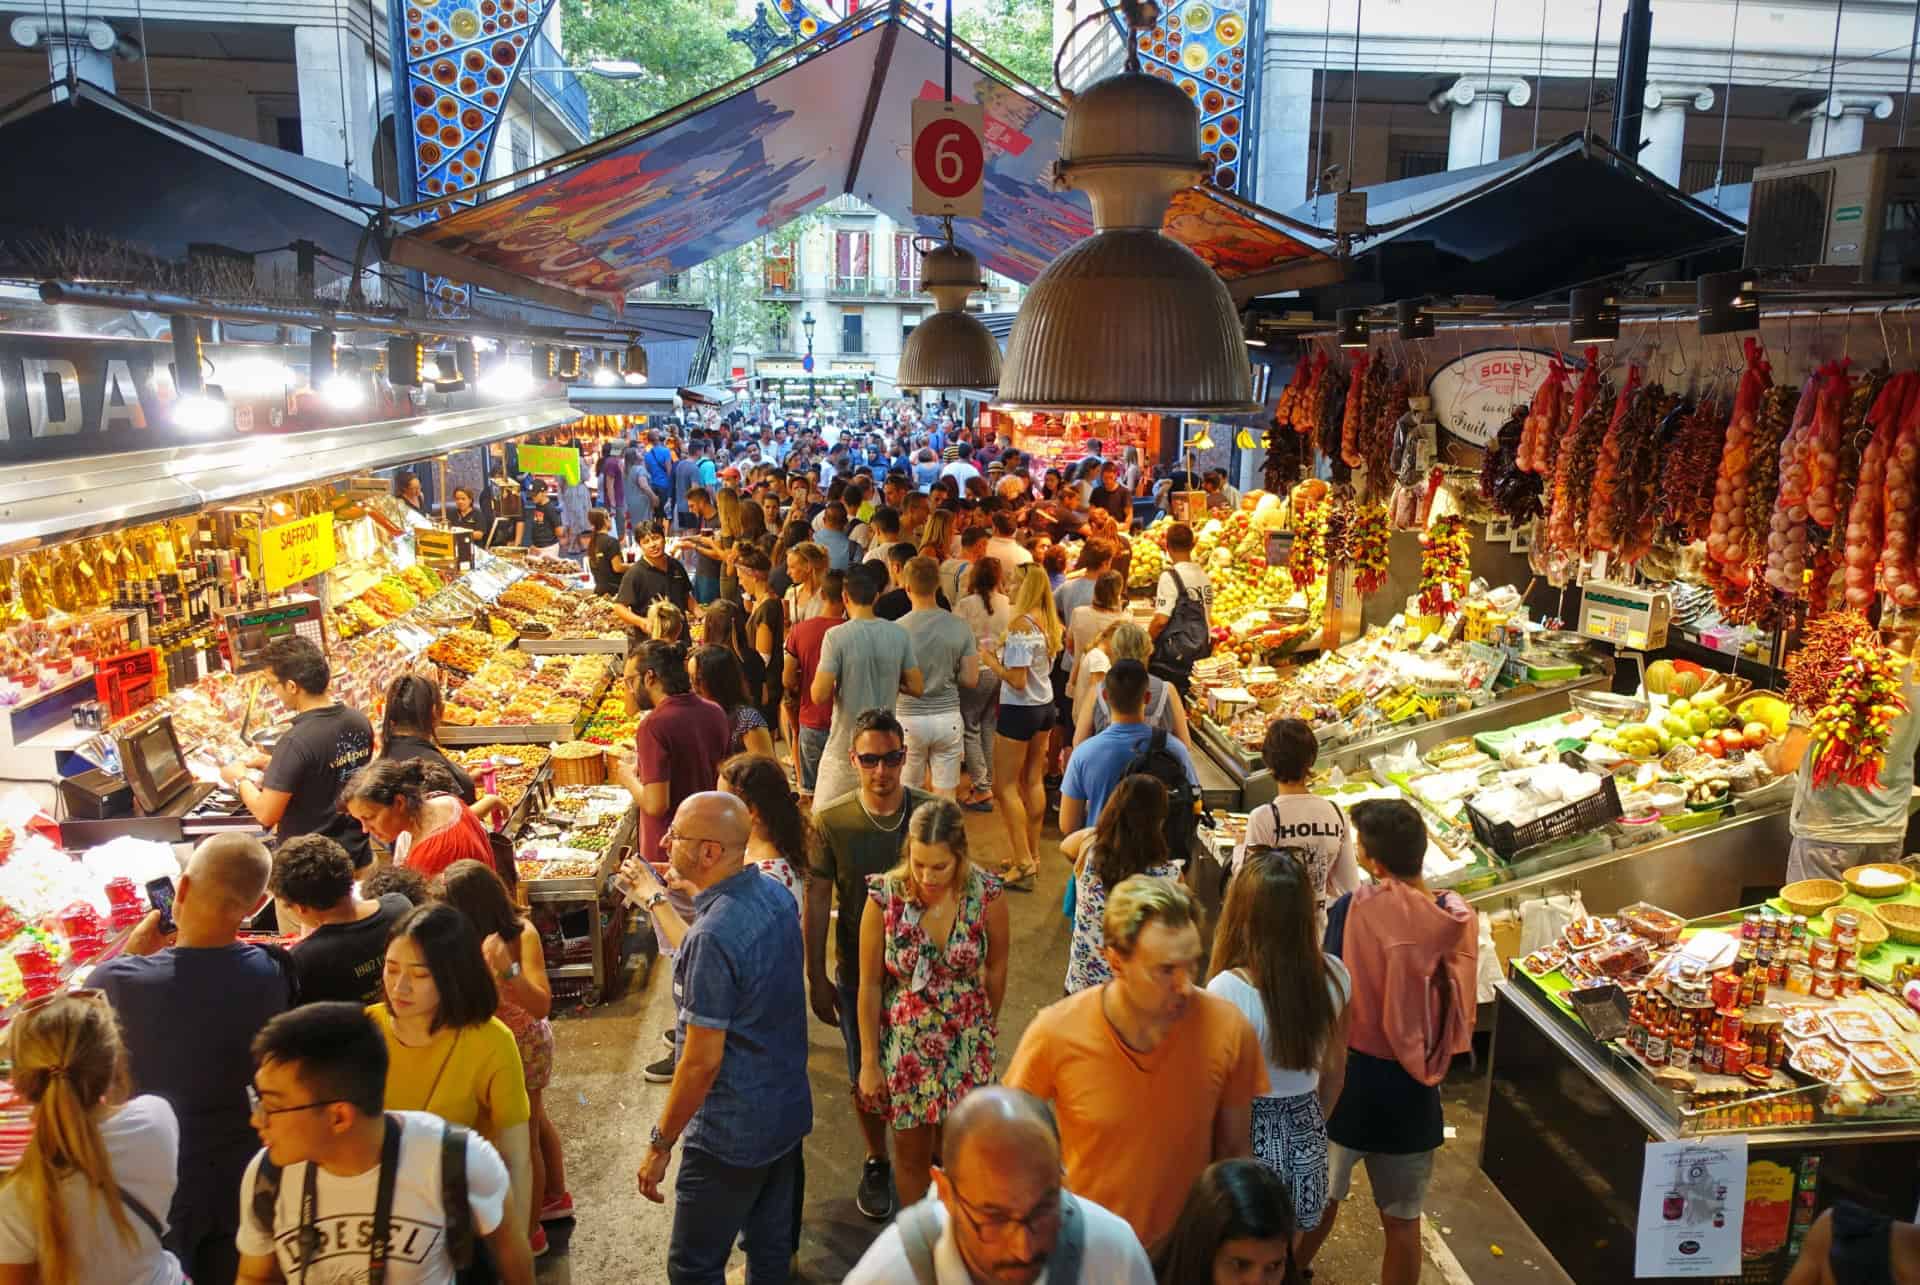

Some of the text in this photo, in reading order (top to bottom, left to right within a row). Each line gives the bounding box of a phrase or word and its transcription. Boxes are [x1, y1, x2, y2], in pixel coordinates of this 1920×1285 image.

[934, 133, 963, 184] 6
[1481, 362, 1533, 378] SOLEY
[280, 521, 319, 550] SAFFRON
[1280, 822, 1344, 838] HOLLI
